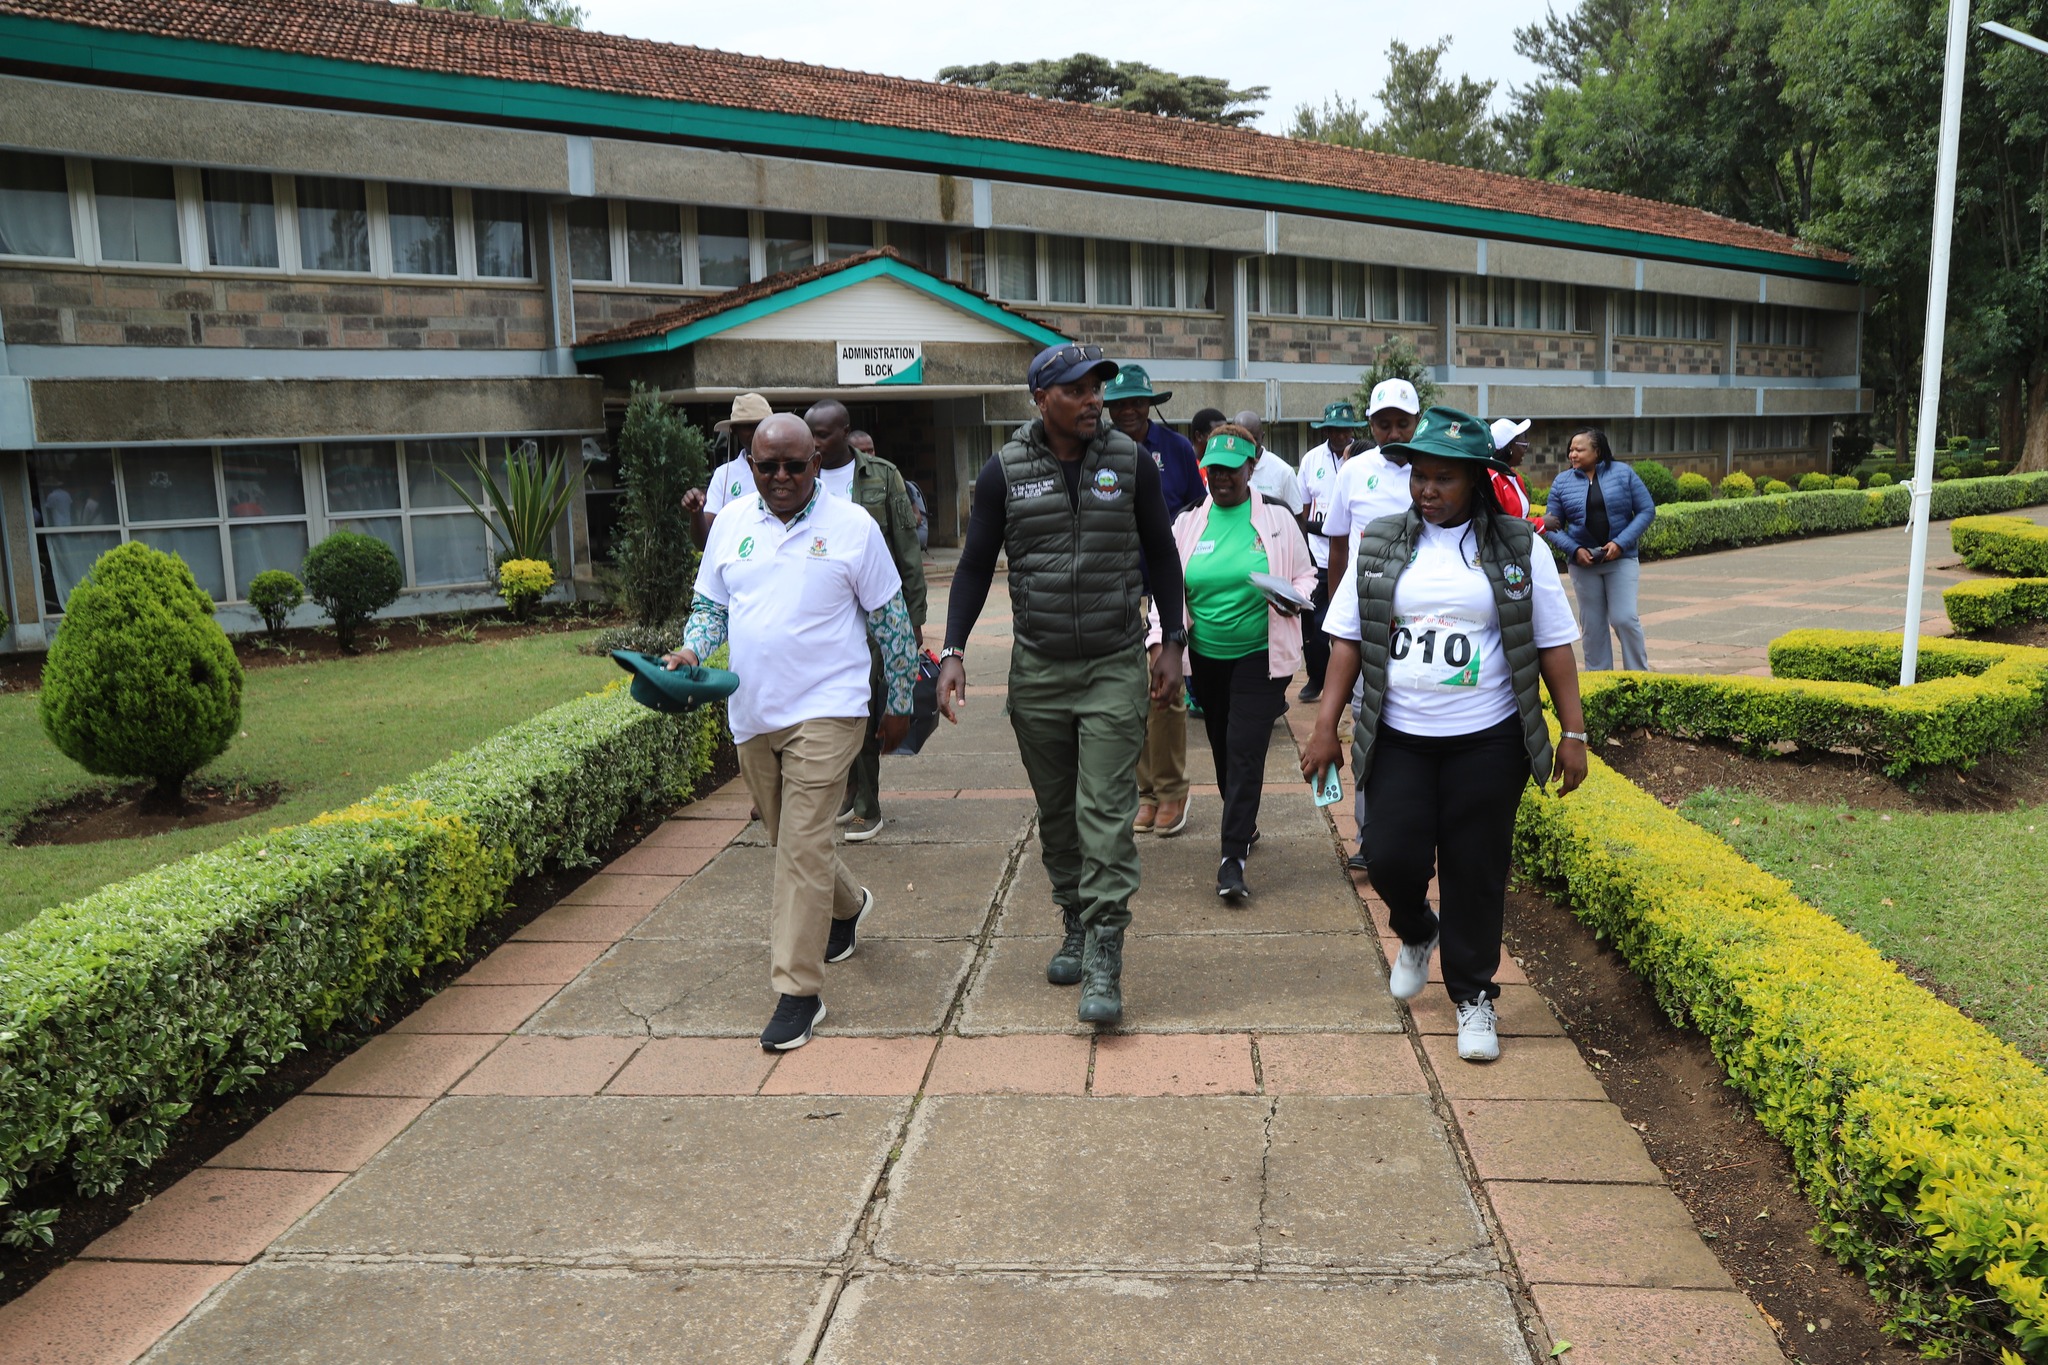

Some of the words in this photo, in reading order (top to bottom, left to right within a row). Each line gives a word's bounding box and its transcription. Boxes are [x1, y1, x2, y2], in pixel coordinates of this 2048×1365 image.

[842, 347, 915, 360] ADMINISTRATION
[864, 364, 894, 377] BLOCK
[1389, 627, 1472, 668] 010
